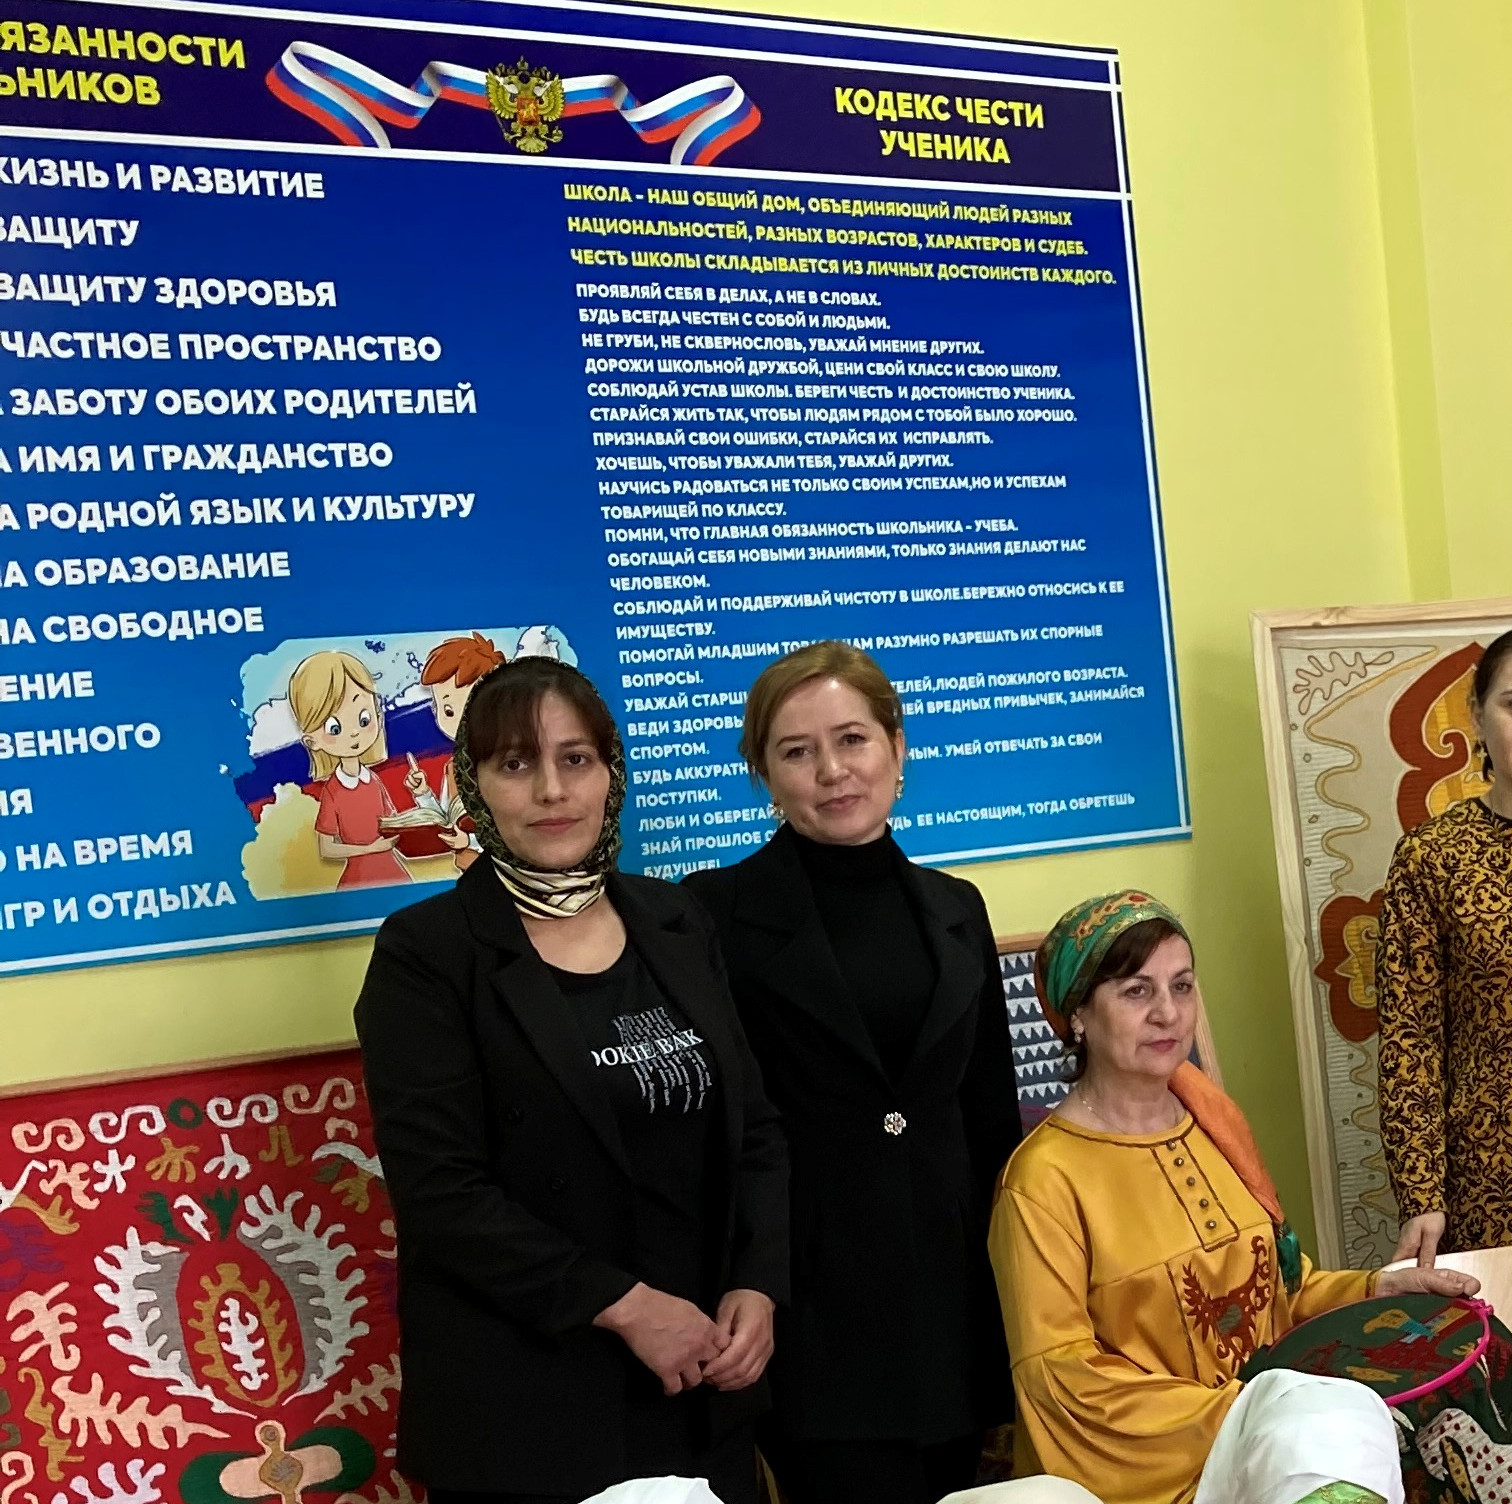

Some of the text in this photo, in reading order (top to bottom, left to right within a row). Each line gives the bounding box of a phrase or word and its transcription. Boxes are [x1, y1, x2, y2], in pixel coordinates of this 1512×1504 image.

[834, 86, 1044, 129] КОДЕКС ЧЕСТИ
[879, 129, 1011, 164] УЧЕНИКА
[115, 163, 142, 190] И
[149, 164, 325, 199] РАЗВИТИЕ
[563, 184, 633, 202] ШКОЛА
[647, 188, 689, 206] НАШ
[692, 190, 758, 211] ОБЩИЙ
[761, 194, 805, 215] ДОМ,
[807, 197, 950, 221] ОБЪЕДИНЯЮЩИЙ
[952, 204, 1010, 224] ЛЮДЕЙ
[1012, 208, 1073, 226] РАЗНЫХ
[567, 216, 1088, 257] НАЦИОНАЛЬНОСТЕЙ, РАЗНЫХ ВОЗРАСТОВ, ХАРАКТЕРОВ И СУДЕБ.
[570, 248, 1117, 286] ЧЕСТЬ ШКОЛЫ СКЛАДЫВАЕТСЯ ИЗ ЛИЧНЫХ ДОСТОИНСТВ КАЖДОГО.
[153, 277, 337, 309] ЗДОРОВЬЯ
[576, 282, 882, 306] ПРОЯВЛЯЙ СЕБЯ В ДЕЛАХ, А НЕ В СЛОВАХ.
[0, 331, 442, 361] ЧАСТНОЕ ПРОСТРАНСТВО
[581, 333, 985, 356] НЕ ГРУБИ, НЕ СКВЕРНОСЛОВЬ, УВАЖАЙ МНЕНИЕ ДРУГИХ.
[584, 356, 1061, 378] ДОРОЖИ ШКОЛЬНОЙ ДРУЖБОЙ, ЦЕНИ СВОЙ КЛАСС И СВОЮ ШКОЛУ.
[9, 388, 148, 415] ЗАБОТУ
[155, 389, 277, 415] ОБОИХ
[283, 382, 477, 419] РОДИТЕЛЕЙ
[587, 380, 1075, 401] СОБЛЮДАЙ УСТАВ ШКОЛЫ. БЕРЕГИ ЧЕСТЬ И ДОСТОИНСТВО УЧЕНИКА.
[592, 428, 993, 447] ПРИЗНАВАЙ СВОИ ОШИБКИ, СТАРАЙСЯ ИХ ИСПРАВЛЯТЬ.
[18, 445, 101, 472] ИМЯ
[109, 445, 135, 471] И
[142, 442, 393, 474] ГРАЖДАНСТВО
[595, 451, 954, 472] ХОЧЕШЬ, ЧТОБЫ УВАЖАЛИ ТЕБЯ, УВАЖАЙ ДРУГИХ.
[598, 475, 1067, 496] НАУЧИСЬ РАДОВАТЬСЯ НЕ ТОЛЬКО СВОИМ УСПЕХАМ,НО И УСПЕХАМ
[26, 492, 475, 533] РОДНОЙ ЯЗЫК И КУЛЬТУРУ
[600, 500, 787, 520] ТОВАРИЩЕЙ ПО КЛАССУ.
[607, 539, 1087, 567] ОБОГАЩАЙ СЕБЯ НОВЫМИ ЗНАНИЯМИ, ТОЛЬКО ЗНАНИЯ ДЕЛАЮТ НАС
[34, 551, 291, 587] ОБРАЗОВАНИЕ
[610, 574, 711, 591] ЧЕЛОВЕКОМ.
[42, 607, 264, 643] СВОБОДНОЕ
[616, 622, 715, 640] ИМУЩЕСТВУ.
[876, 633, 940, 648] РАЗУМНО
[942, 629, 1019, 645] РАЗРЕШАТЬ
[1020, 628, 1038, 641] ИХ
[1040, 624, 1103, 640] СПОРНЫЕ
[622, 671, 704, 689] ВОПРОСЫ.
[927, 685, 1145, 713] ВРЕДНЫХ ПРИВЫЧЕК, ЗАНИМАЙСЯ
[630, 743, 710, 761] СПОРТОМ.
[636, 789, 722, 808] ПОСТУПКИ.
[15, 842, 67, 871] НА
[73, 830, 193, 865] ВРЕМЯ
[53, 897, 78, 924] И
[87, 881, 236, 920] ОТДЫХА
